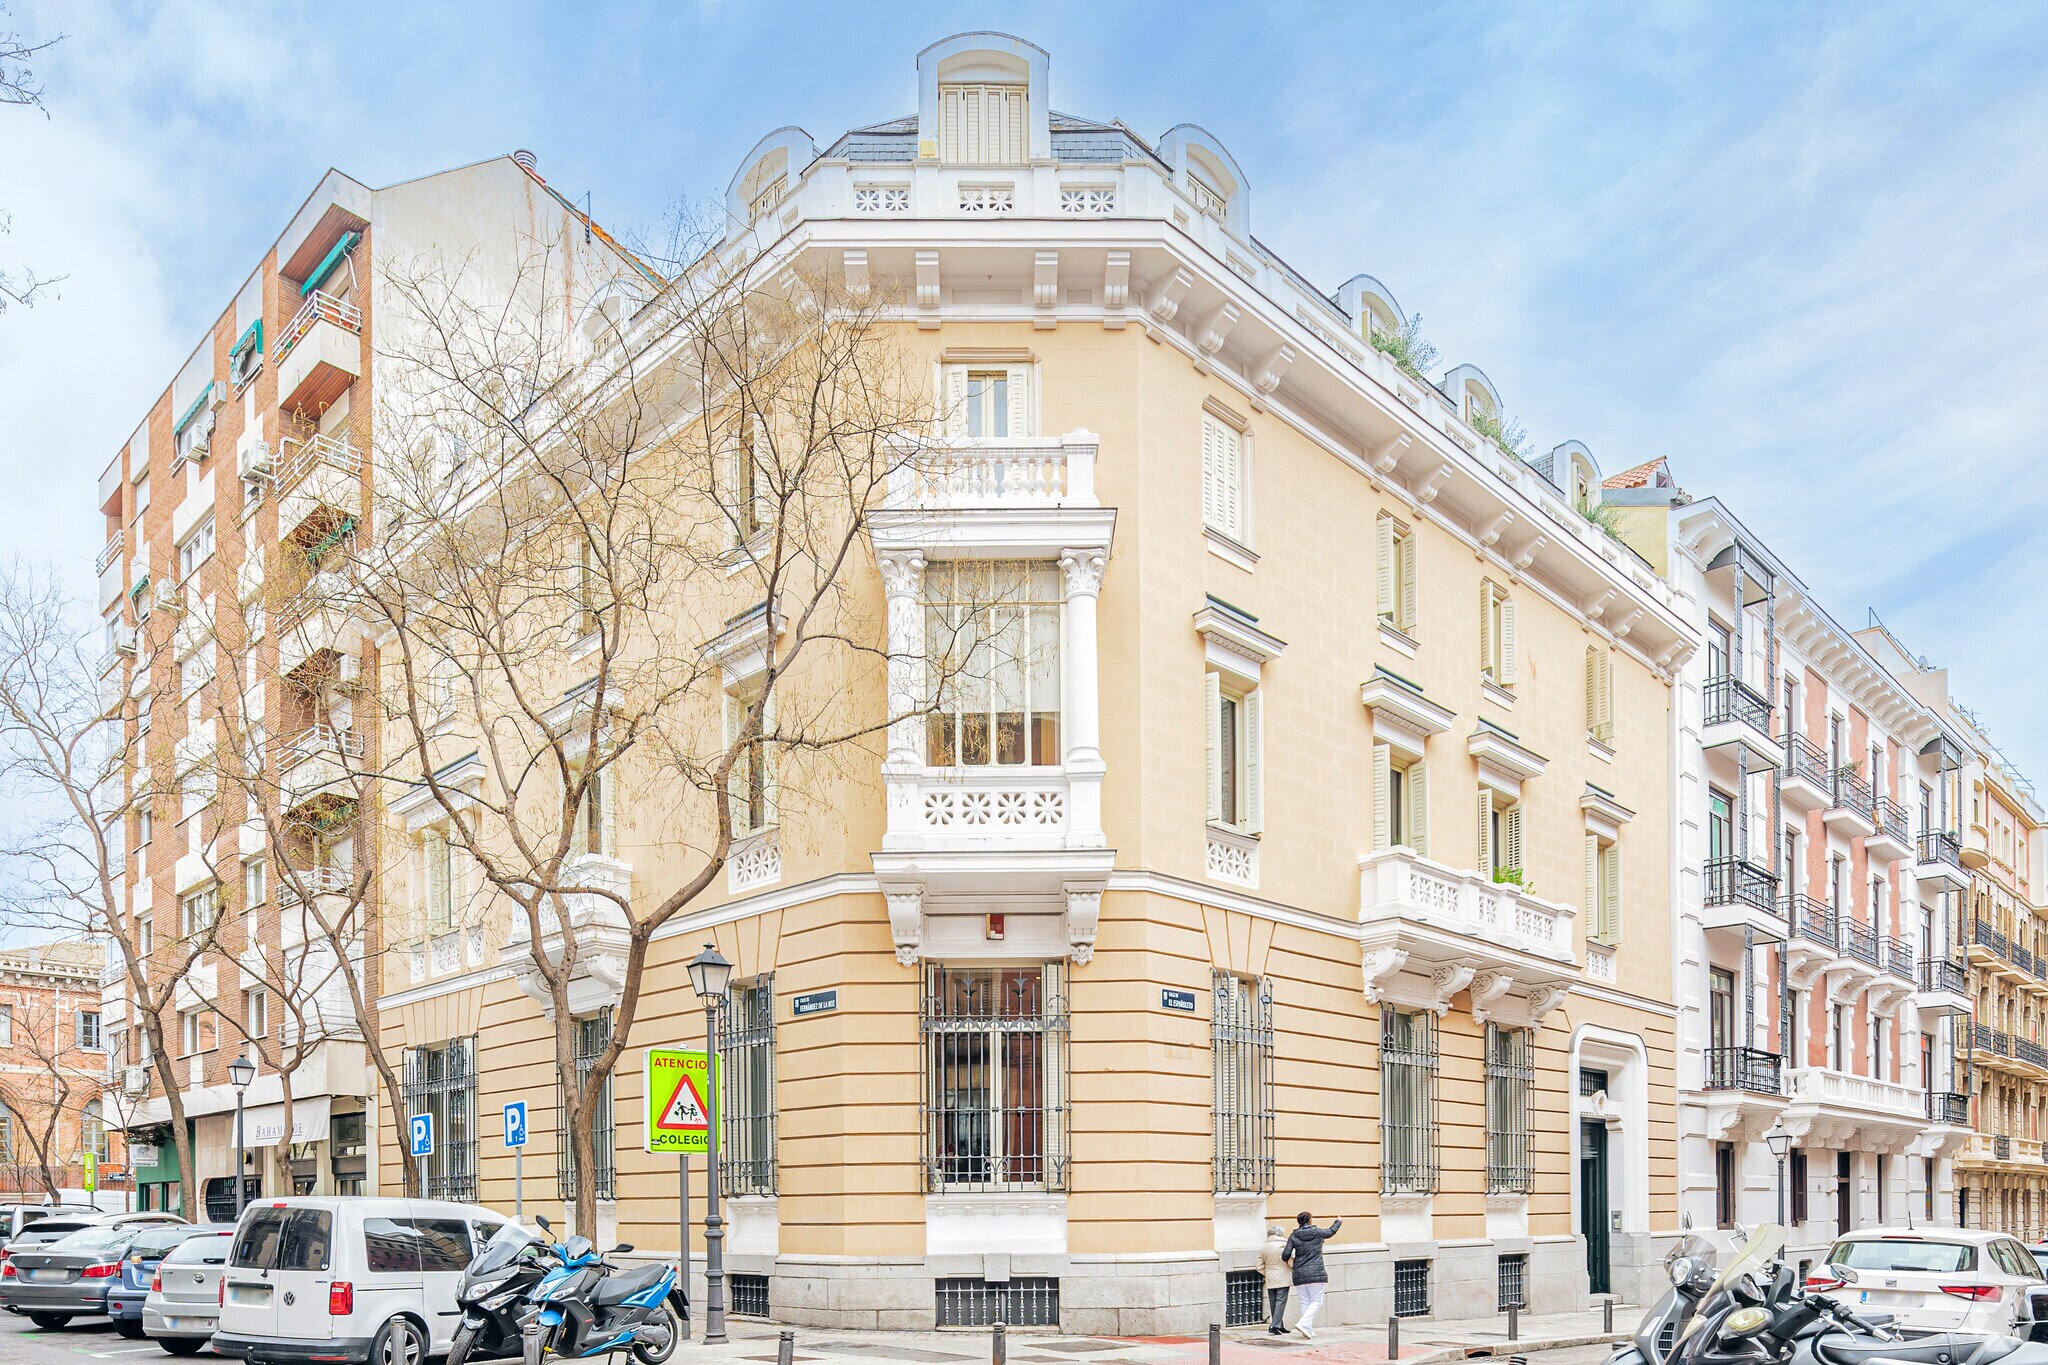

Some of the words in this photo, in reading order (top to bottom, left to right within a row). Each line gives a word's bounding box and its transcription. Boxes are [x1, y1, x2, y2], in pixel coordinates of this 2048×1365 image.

[800, 1002, 818, 1012] FERNÁNDEZ
[654, 1058, 707, 1070] ATENCIO
[256, 1123, 302, 1137] BAHAMDE
